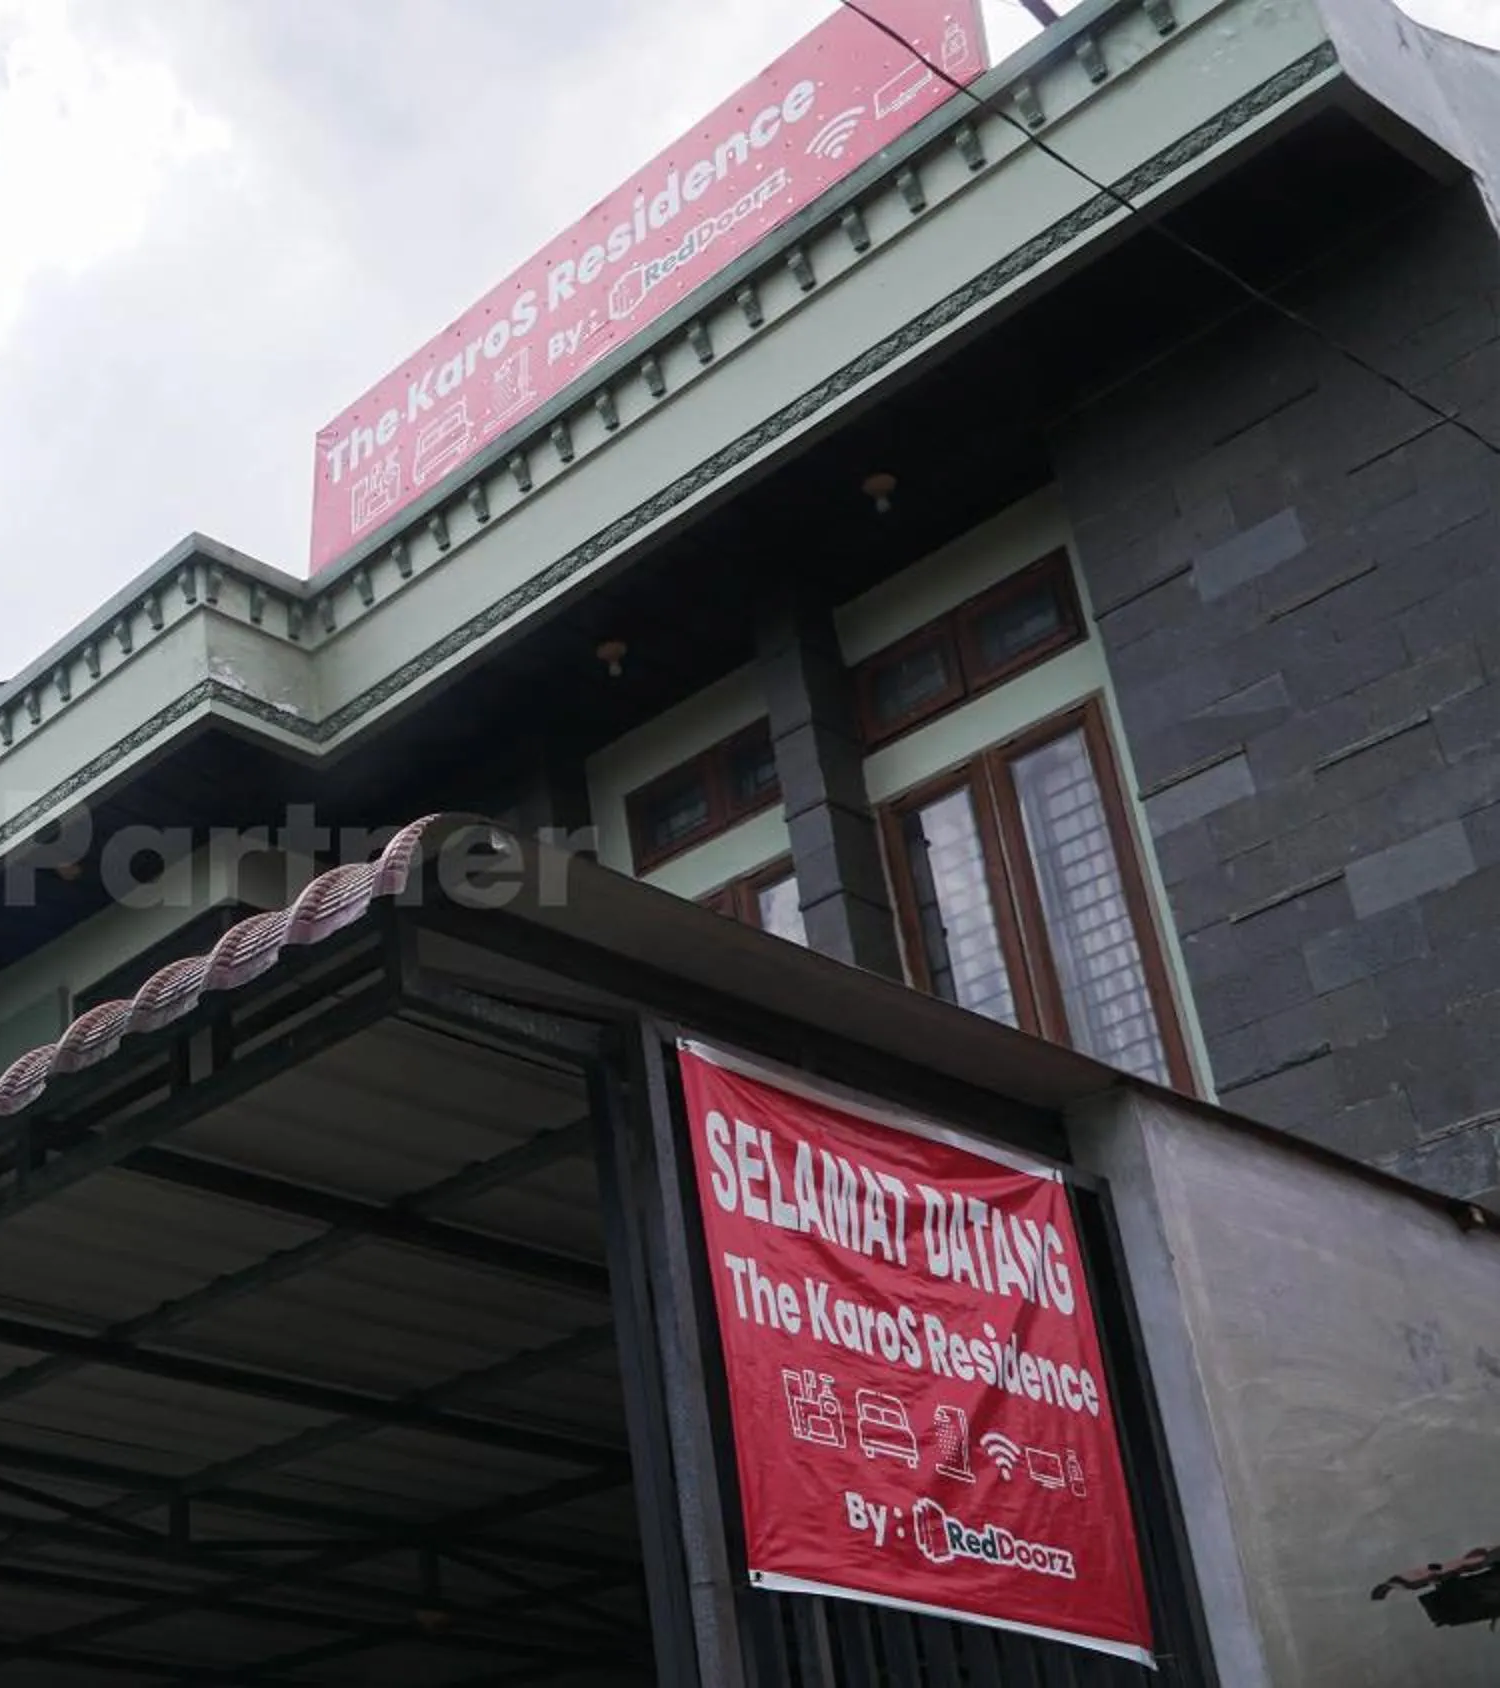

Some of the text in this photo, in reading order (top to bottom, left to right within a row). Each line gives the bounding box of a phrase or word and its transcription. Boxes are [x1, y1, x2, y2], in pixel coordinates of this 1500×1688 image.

[327, 79, 816, 484] The KaroS Residence
[547, 319, 583, 365] By
[642, 167, 788, 289] RedDoorz
[704, 1109, 1075, 1315] SELAMAT DATANG
[723, 1251, 1100, 1418] The KaroS Residence
[845, 1491, 887, 1547] By
[945, 1516, 1077, 1579] RedDoorz
